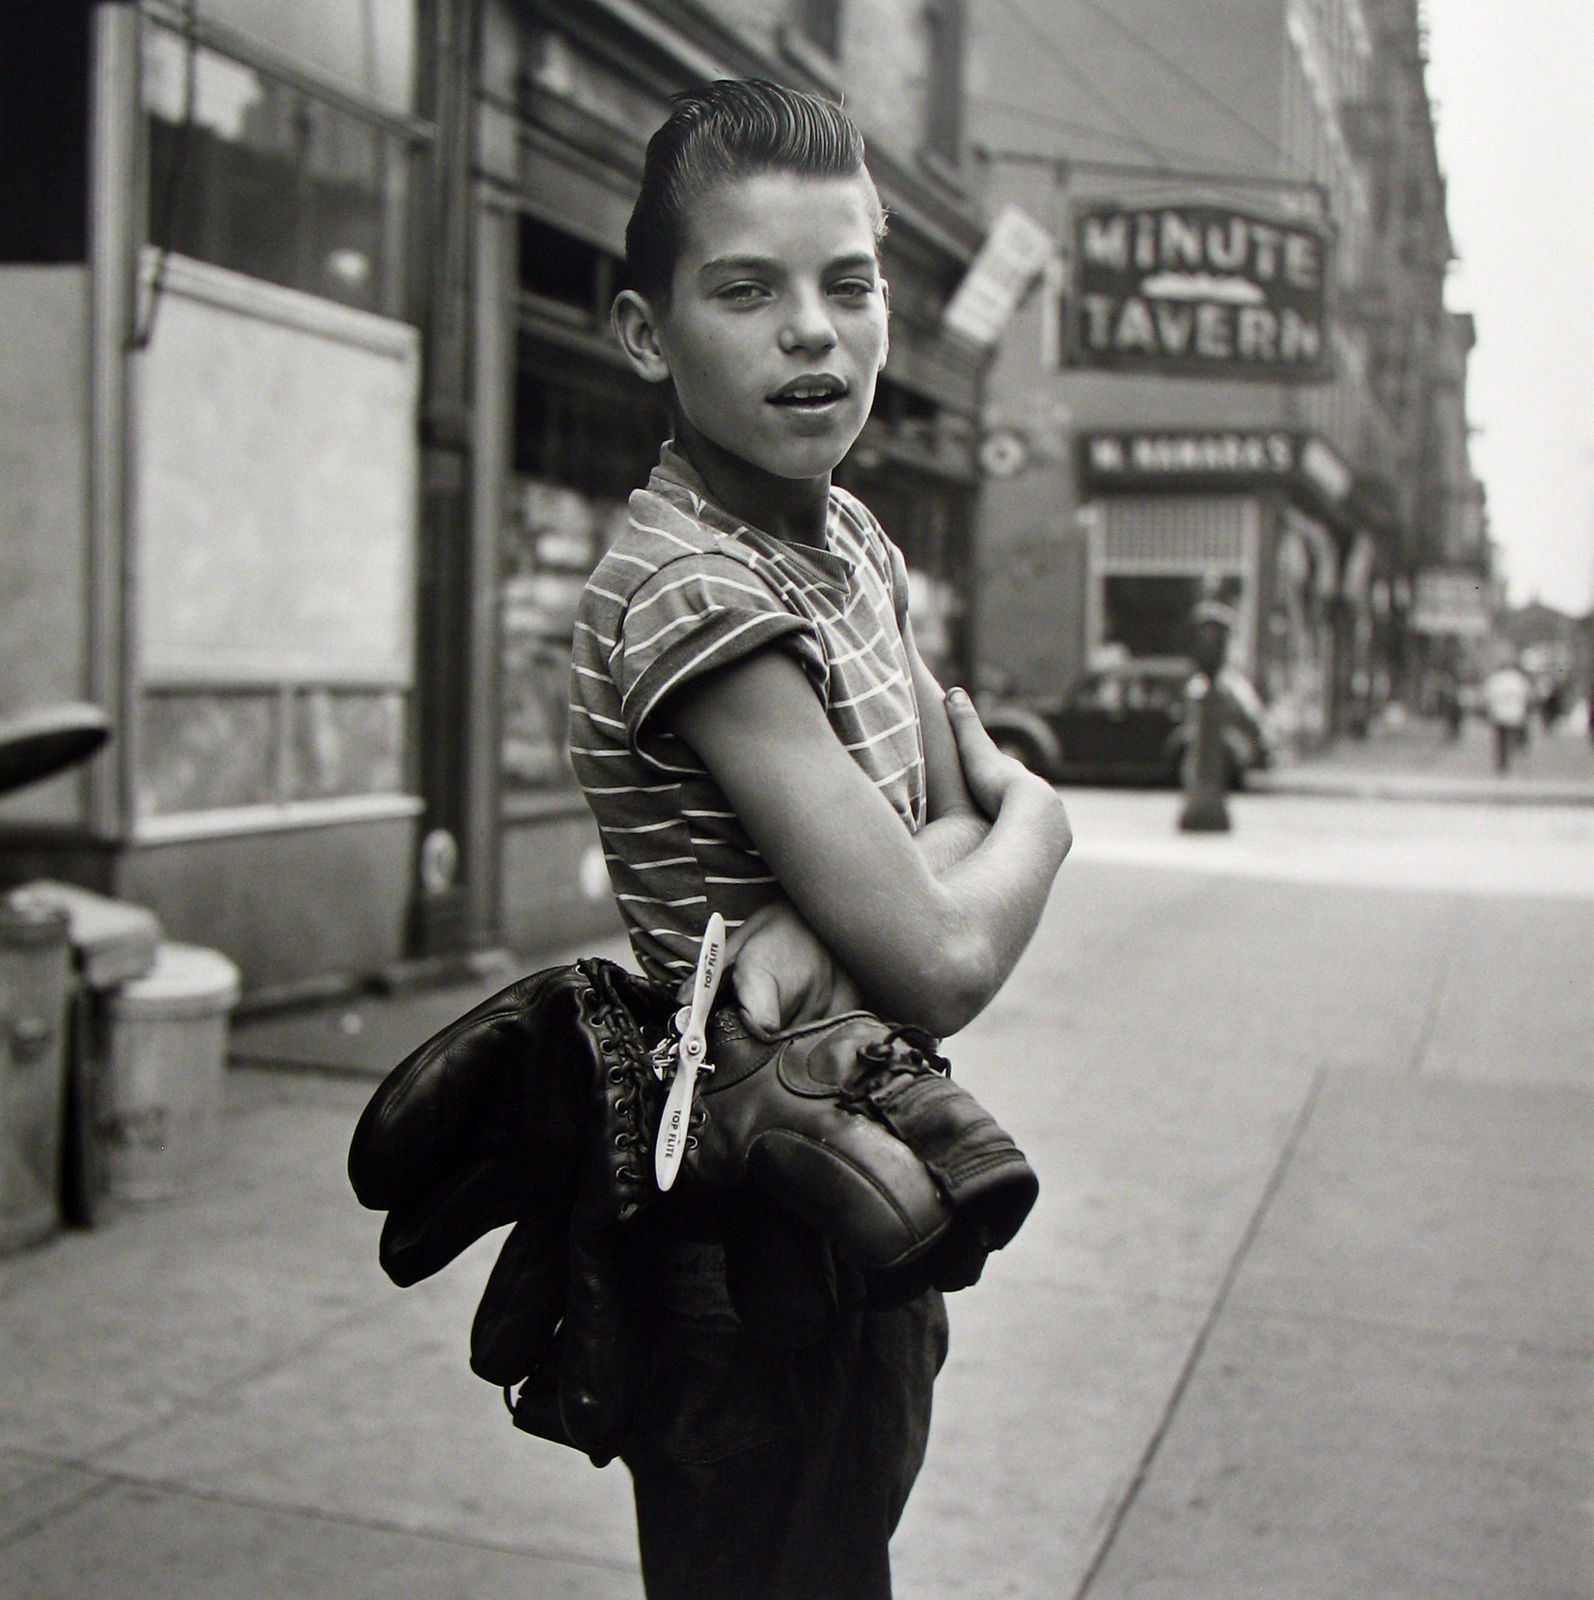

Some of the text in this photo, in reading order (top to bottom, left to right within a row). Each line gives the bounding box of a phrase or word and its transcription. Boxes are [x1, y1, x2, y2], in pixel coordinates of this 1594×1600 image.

[1084, 211, 1320, 289] MINUTE
[1084, 295, 1320, 361] TAVERN
[704, 943, 719, 988] TOP FLITE
[665, 1110, 681, 1158] TOP FLITE
